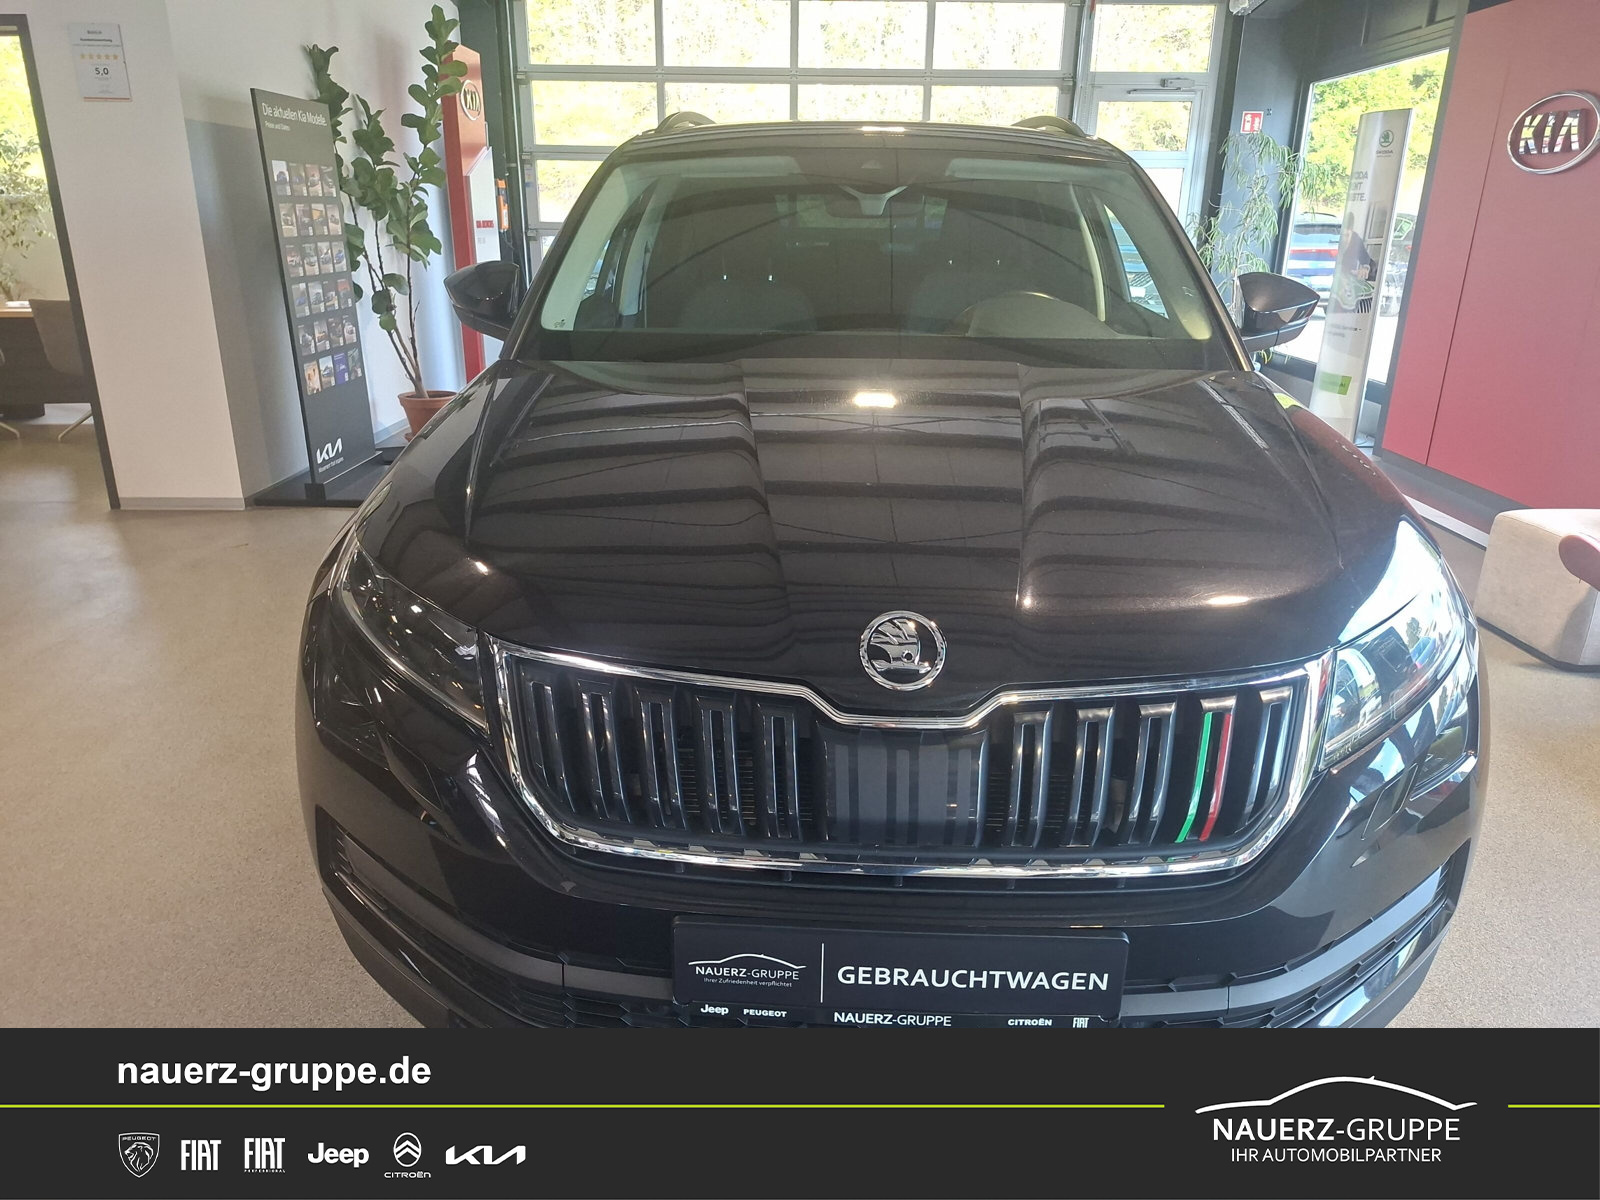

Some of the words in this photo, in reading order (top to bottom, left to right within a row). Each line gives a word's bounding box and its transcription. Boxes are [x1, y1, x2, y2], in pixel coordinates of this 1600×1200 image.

[94, 67, 109, 76] 5,0
[261, 102, 273, 117] Die
[1518, 110, 1581, 155] KIA
[695, 966, 800, 980] NAUERZ-GRUPPE
[837, 965, 1109, 991] GEBRAUCHTWAGEN
[718, 978, 759, 986] Zufriedenheit
[758, 980, 793, 988] verpflichtet
[700, 1004, 729, 1016] Jeep
[743, 1008, 788, 1018] PEUGEOT
[833, 1011, 952, 1027] NAUERZ-GRUPPE
[1007, 1018, 1053, 1027] CITROËN
[1072, 1017, 1090, 1028] FIAT
